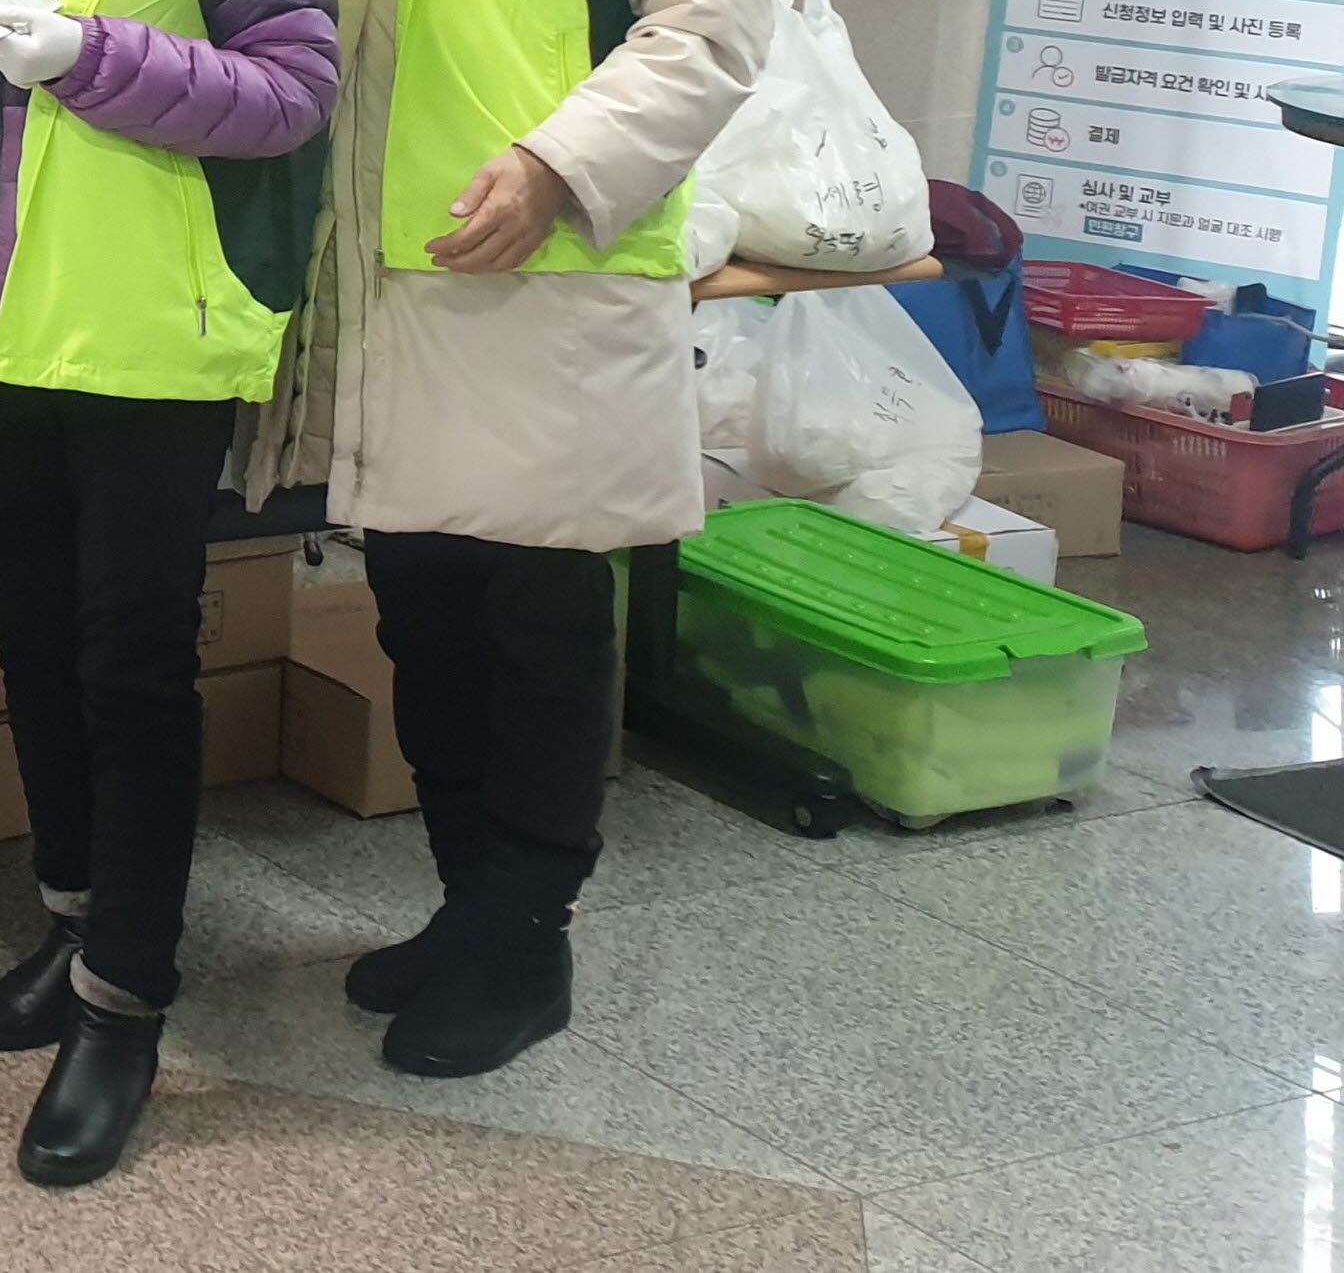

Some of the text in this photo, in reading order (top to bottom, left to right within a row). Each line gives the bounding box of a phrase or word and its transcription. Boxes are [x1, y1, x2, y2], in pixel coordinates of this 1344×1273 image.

[1102, 2, 1302, 41] 신청정보 입력 및 사진 등록
[1095, 64, 1159, 88] 발급자격
[1160, 72, 1194, 93] 요건
[1197, 76, 1231, 97] 확인
[1234, 80, 1250, 100] 및
[1087, 124, 1120, 145] 결제
[1081, 179, 1172, 206] 심사 및 교부
[1142, 208, 1154, 222] 시
